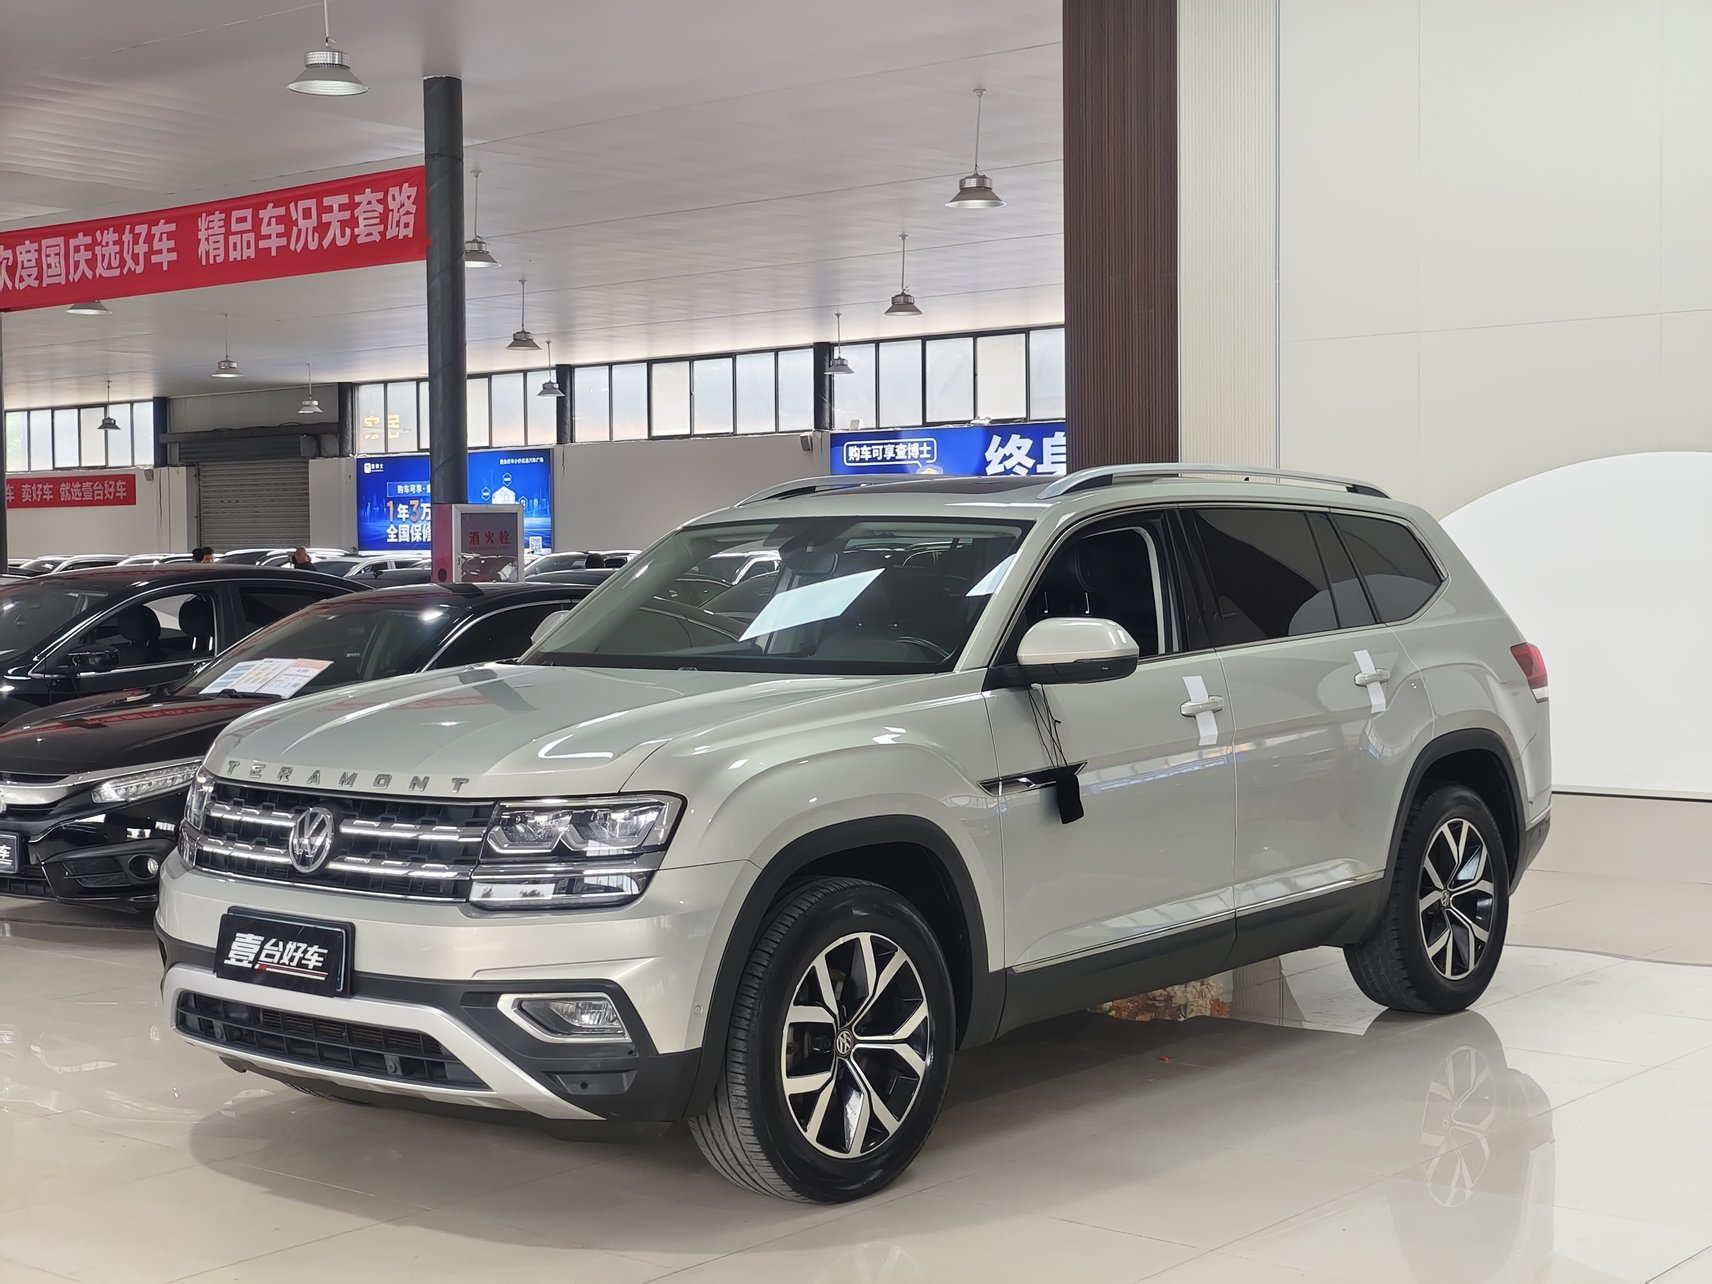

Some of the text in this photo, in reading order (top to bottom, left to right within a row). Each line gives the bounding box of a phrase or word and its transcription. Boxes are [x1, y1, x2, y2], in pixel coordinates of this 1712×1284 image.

[197, 183, 417, 265] 精品车况无套路
[848, 442, 932, 461] 购车可享查博士
[21, 483, 54, 503] 卖好车
[60, 480, 127, 501] 就选壹台好车
[469, 531, 510, 545] 消火栓
[227, 759, 469, 793] TERAMONT
[223, 932, 329, 970] 壹台好车
